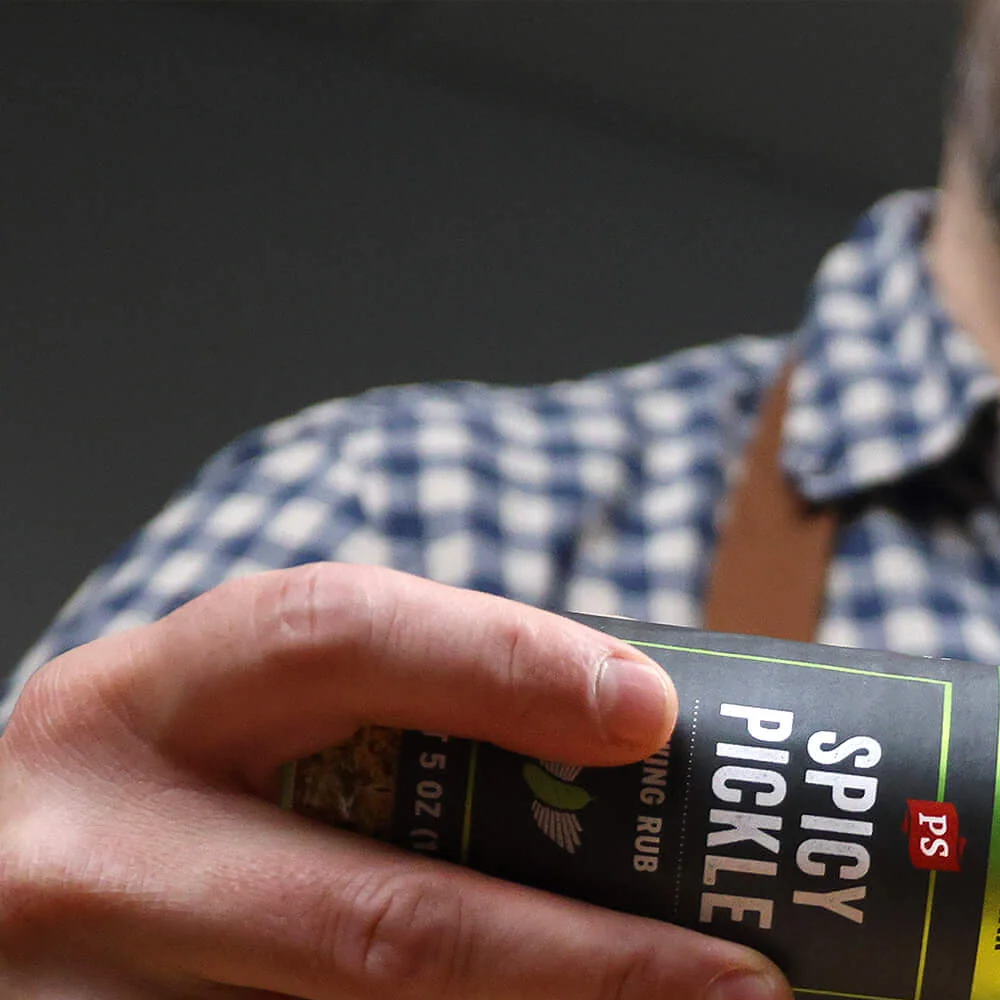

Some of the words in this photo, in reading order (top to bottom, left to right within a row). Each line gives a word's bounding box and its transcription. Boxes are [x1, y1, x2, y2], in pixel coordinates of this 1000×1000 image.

[414, 780, 443, 818] OZ
[700, 703, 794, 929] PICKLE
[792, 730, 882, 924] SPICY
[633, 815, 663, 873] RUB
[918, 812, 948, 857] PS
